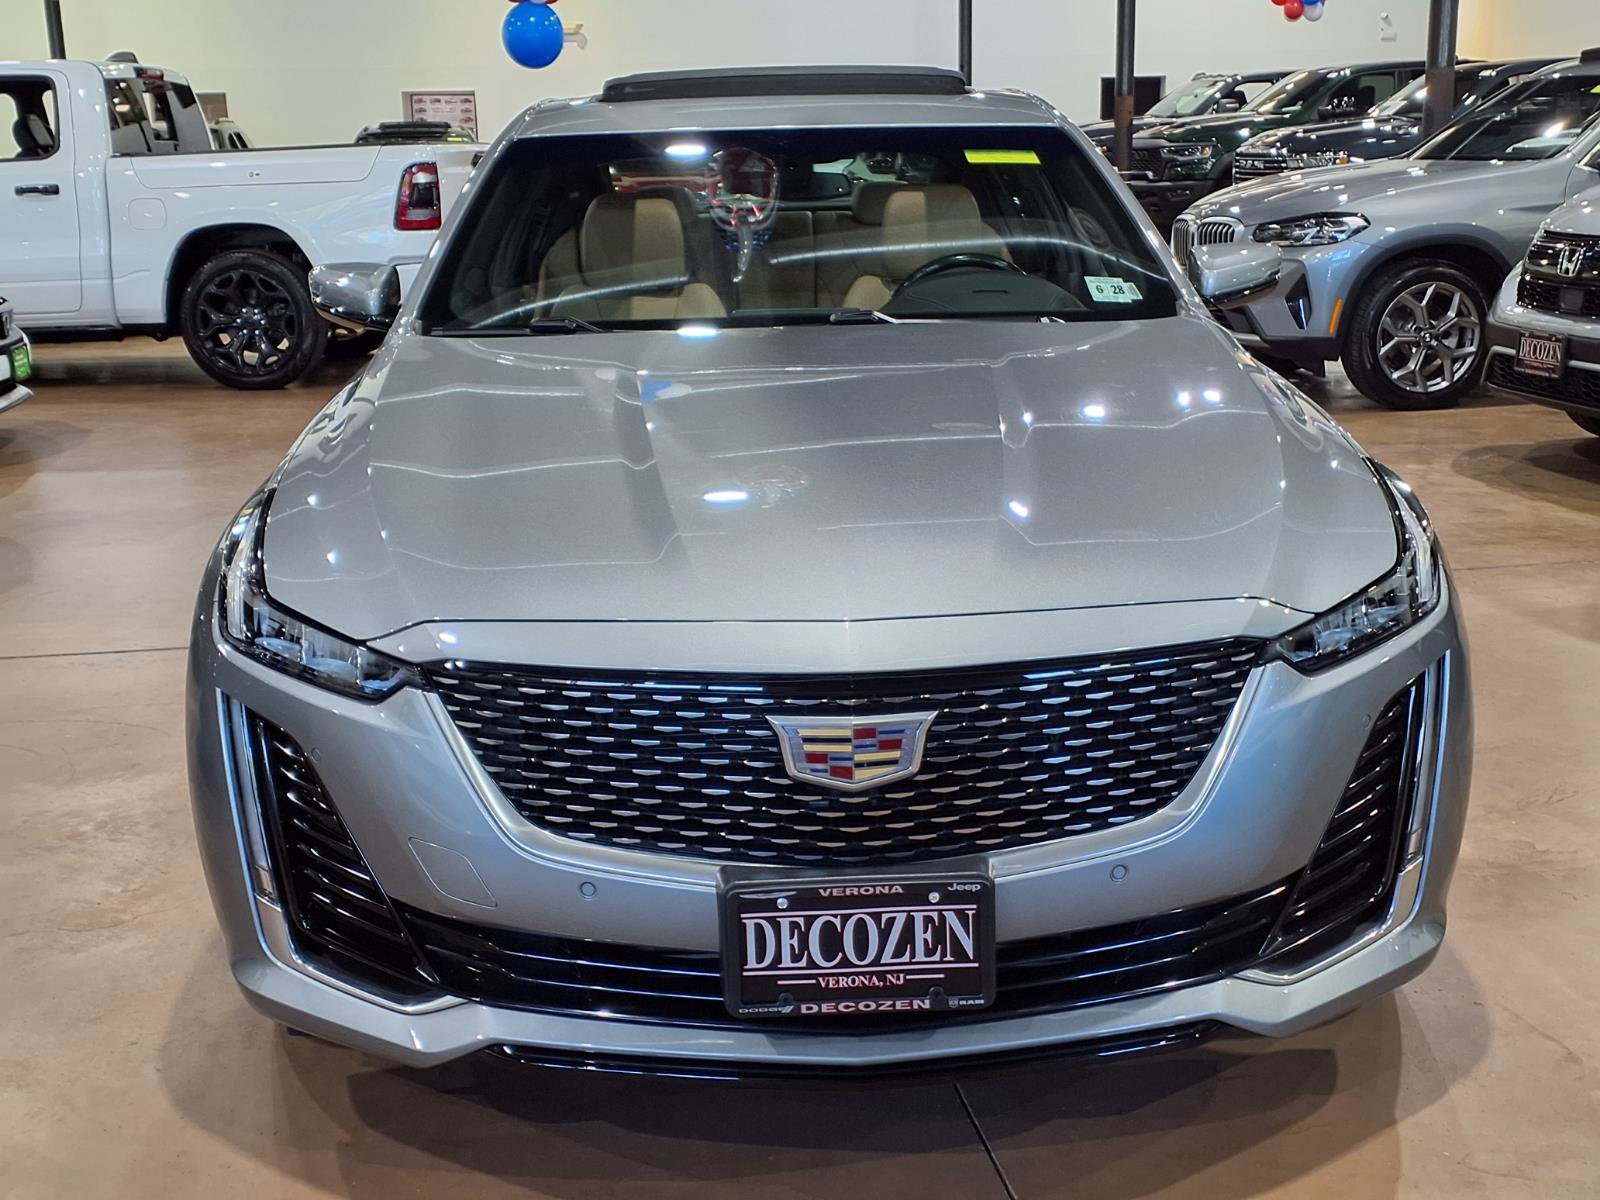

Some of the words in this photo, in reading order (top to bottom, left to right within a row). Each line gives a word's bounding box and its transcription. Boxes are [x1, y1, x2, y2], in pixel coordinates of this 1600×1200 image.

[1095, 284, 1104, 294] 6
[1110, 284, 1125, 295] 28
[1520, 339, 1561, 363] DECOZEN
[818, 885, 904, 897] VERONA
[947, 883, 981, 892] Jeep
[741, 910, 977, 969] DECOZEN
[818, 974, 883, 988] VERONA,
[886, 973, 905, 985] NJ
[800, 999, 930, 1014] DECOZEN
